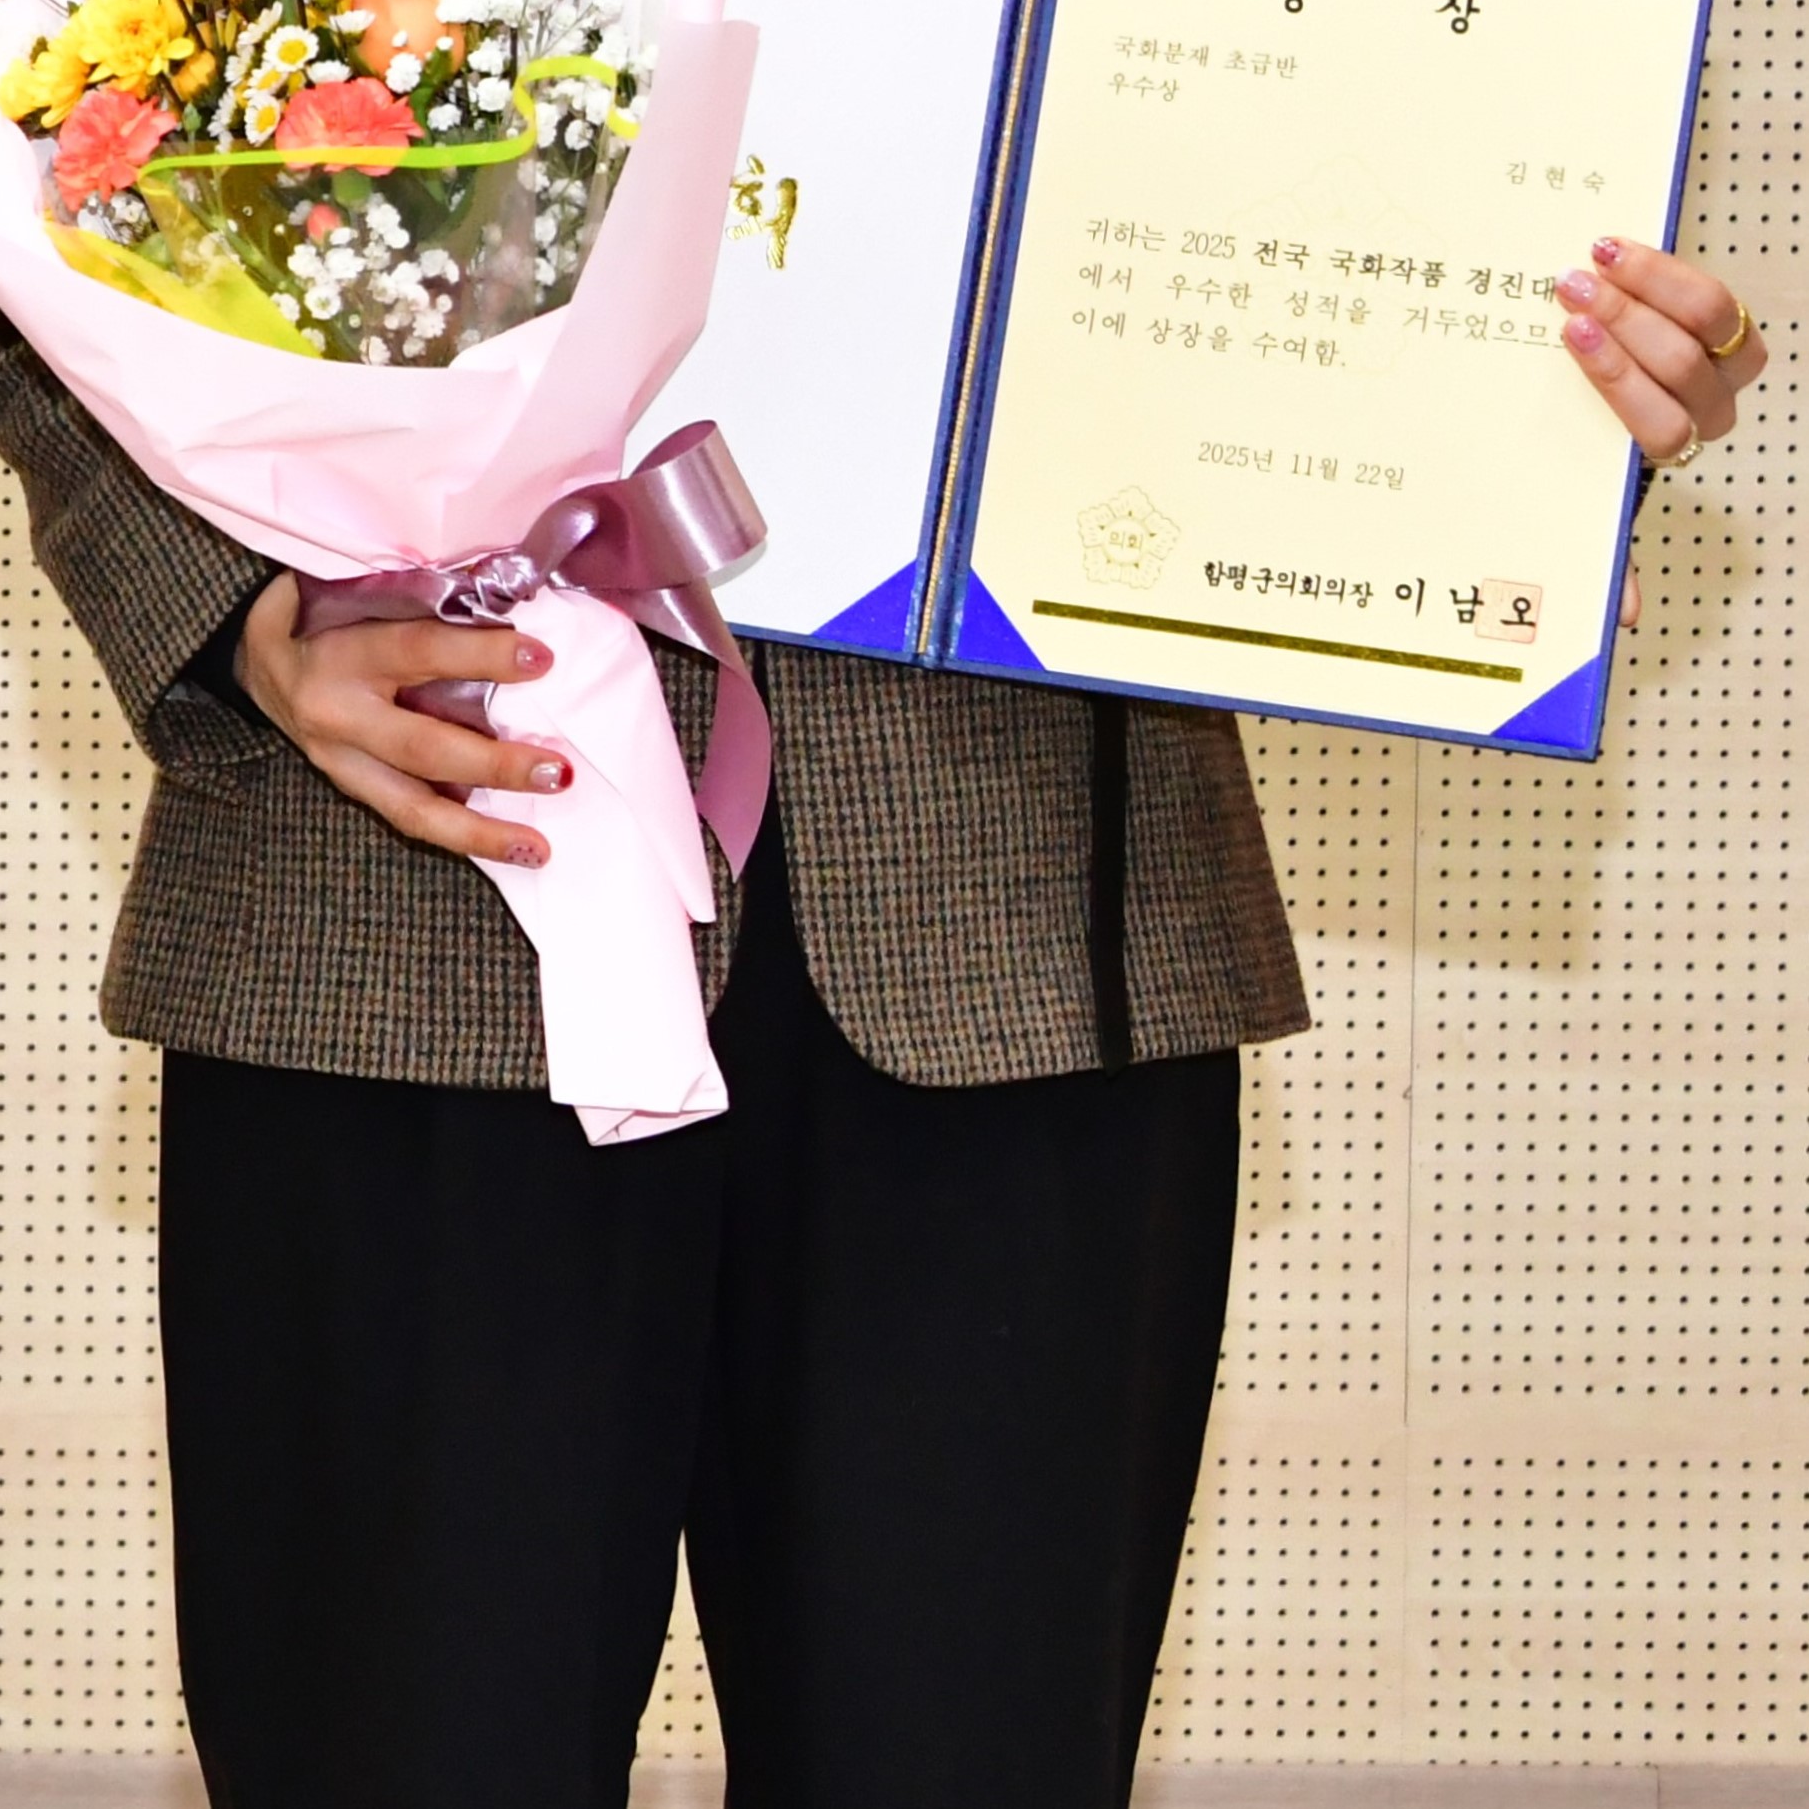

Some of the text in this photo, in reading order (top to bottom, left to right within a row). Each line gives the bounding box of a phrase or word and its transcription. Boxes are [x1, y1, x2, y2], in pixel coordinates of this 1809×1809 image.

[1114, 35, 1298, 80] 국화분재 초급반
[1108, 72, 1180, 103] 우수상
[1506, 161, 1606, 195] 김 현 숙
[726, 154, 798, 270] 회
[1086, 218, 1557, 304] 귀하는 2025 전국 국화작품 경진대
[1078, 262, 1566, 350] 에서 우수한 성적을 거두었으므
[1071, 307, 1346, 367] 이에 상장을 수여함.
[1197, 441, 1405, 491] 2025년 11월 22일
[1395, 577, 1426, 616] 이
[1449, 585, 1485, 624] 남
[1499, 596, 1537, 629] 오
